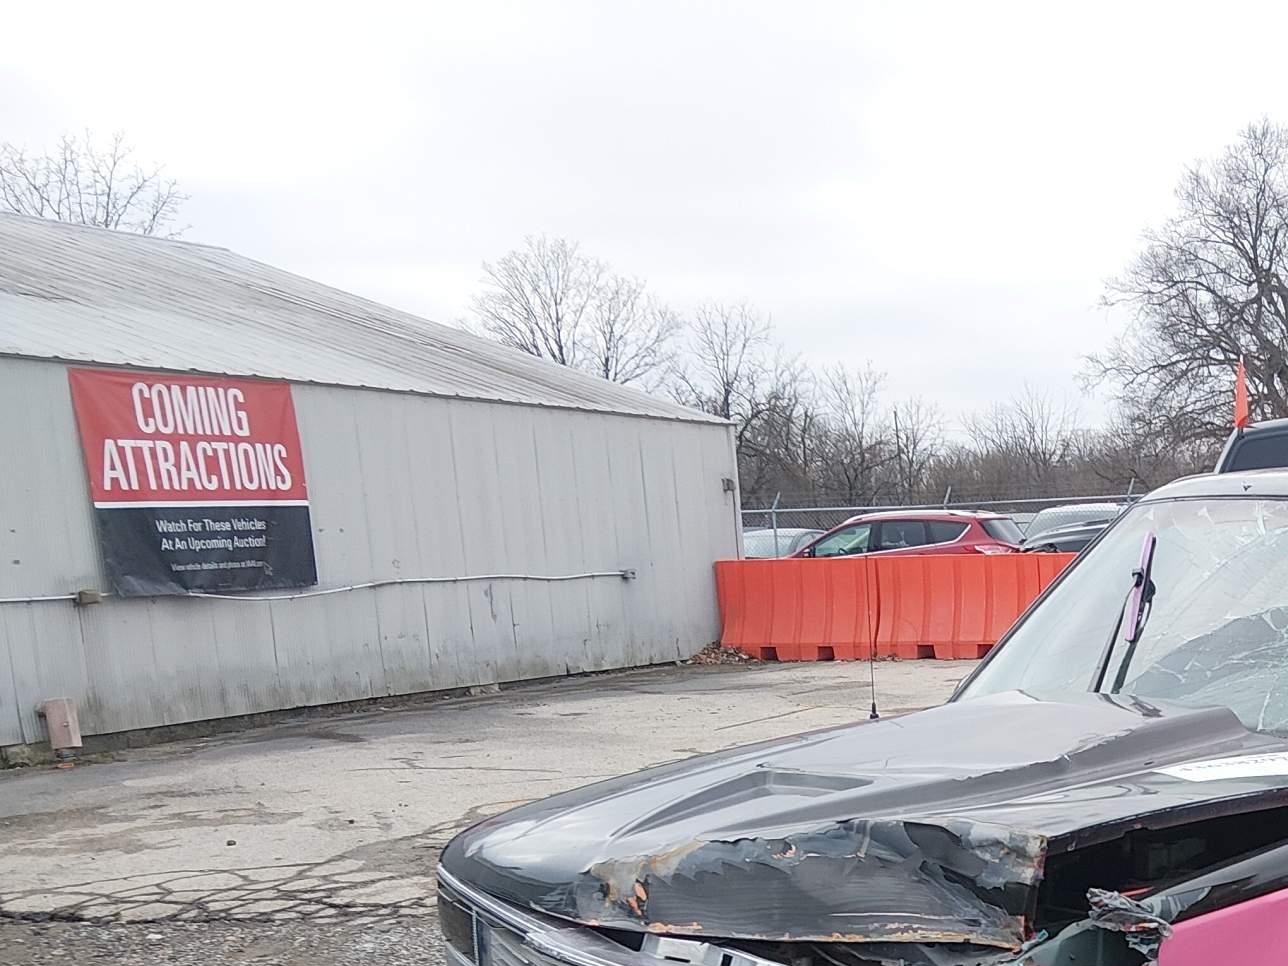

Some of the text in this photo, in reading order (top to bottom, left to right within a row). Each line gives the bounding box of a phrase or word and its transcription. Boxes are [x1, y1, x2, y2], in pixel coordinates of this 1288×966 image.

[131, 382, 250, 437] COMING
[103, 439, 292, 491] ATTRACTIONS
[155, 518, 267, 533] Watch For These Vehicles
[161, 534, 266, 552] At An Upcoming Auction!
